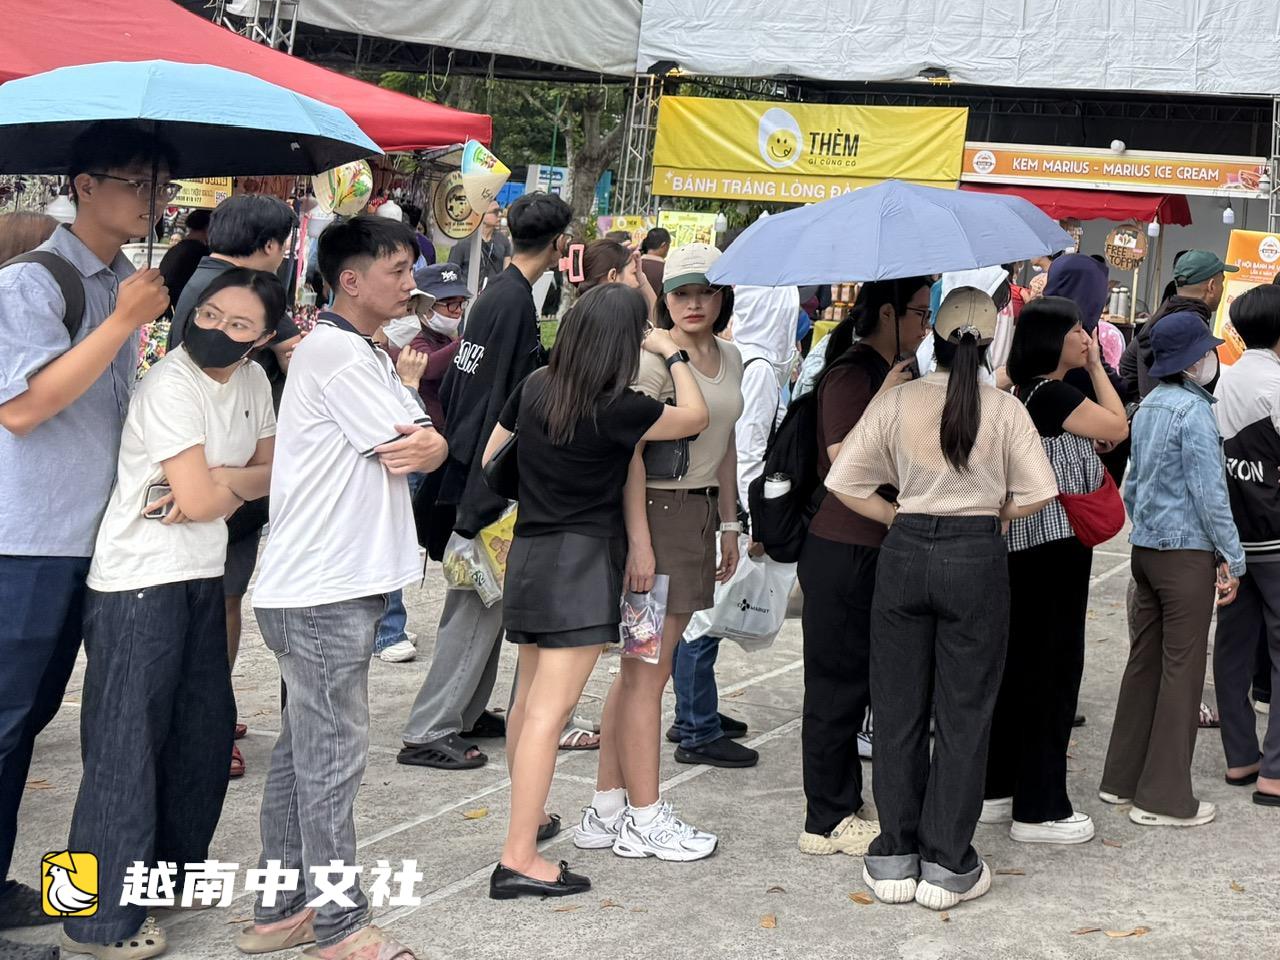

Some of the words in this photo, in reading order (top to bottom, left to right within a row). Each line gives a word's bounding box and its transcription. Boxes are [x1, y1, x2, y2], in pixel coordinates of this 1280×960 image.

[809, 128, 860, 157] THÈM
[1012, 157, 1039, 171] KEM
[1043, 159, 1090, 174] MARIUS
[1103, 163, 1151, 177] MARIUS
[1154, 165, 1173, 178] ICE
[1177, 166, 1219, 181] CREAM
[672, 174, 717, 193] BÁNH
[722, 177, 776, 196] TRÁNG
[1107, 244, 1128, 257] FREE
